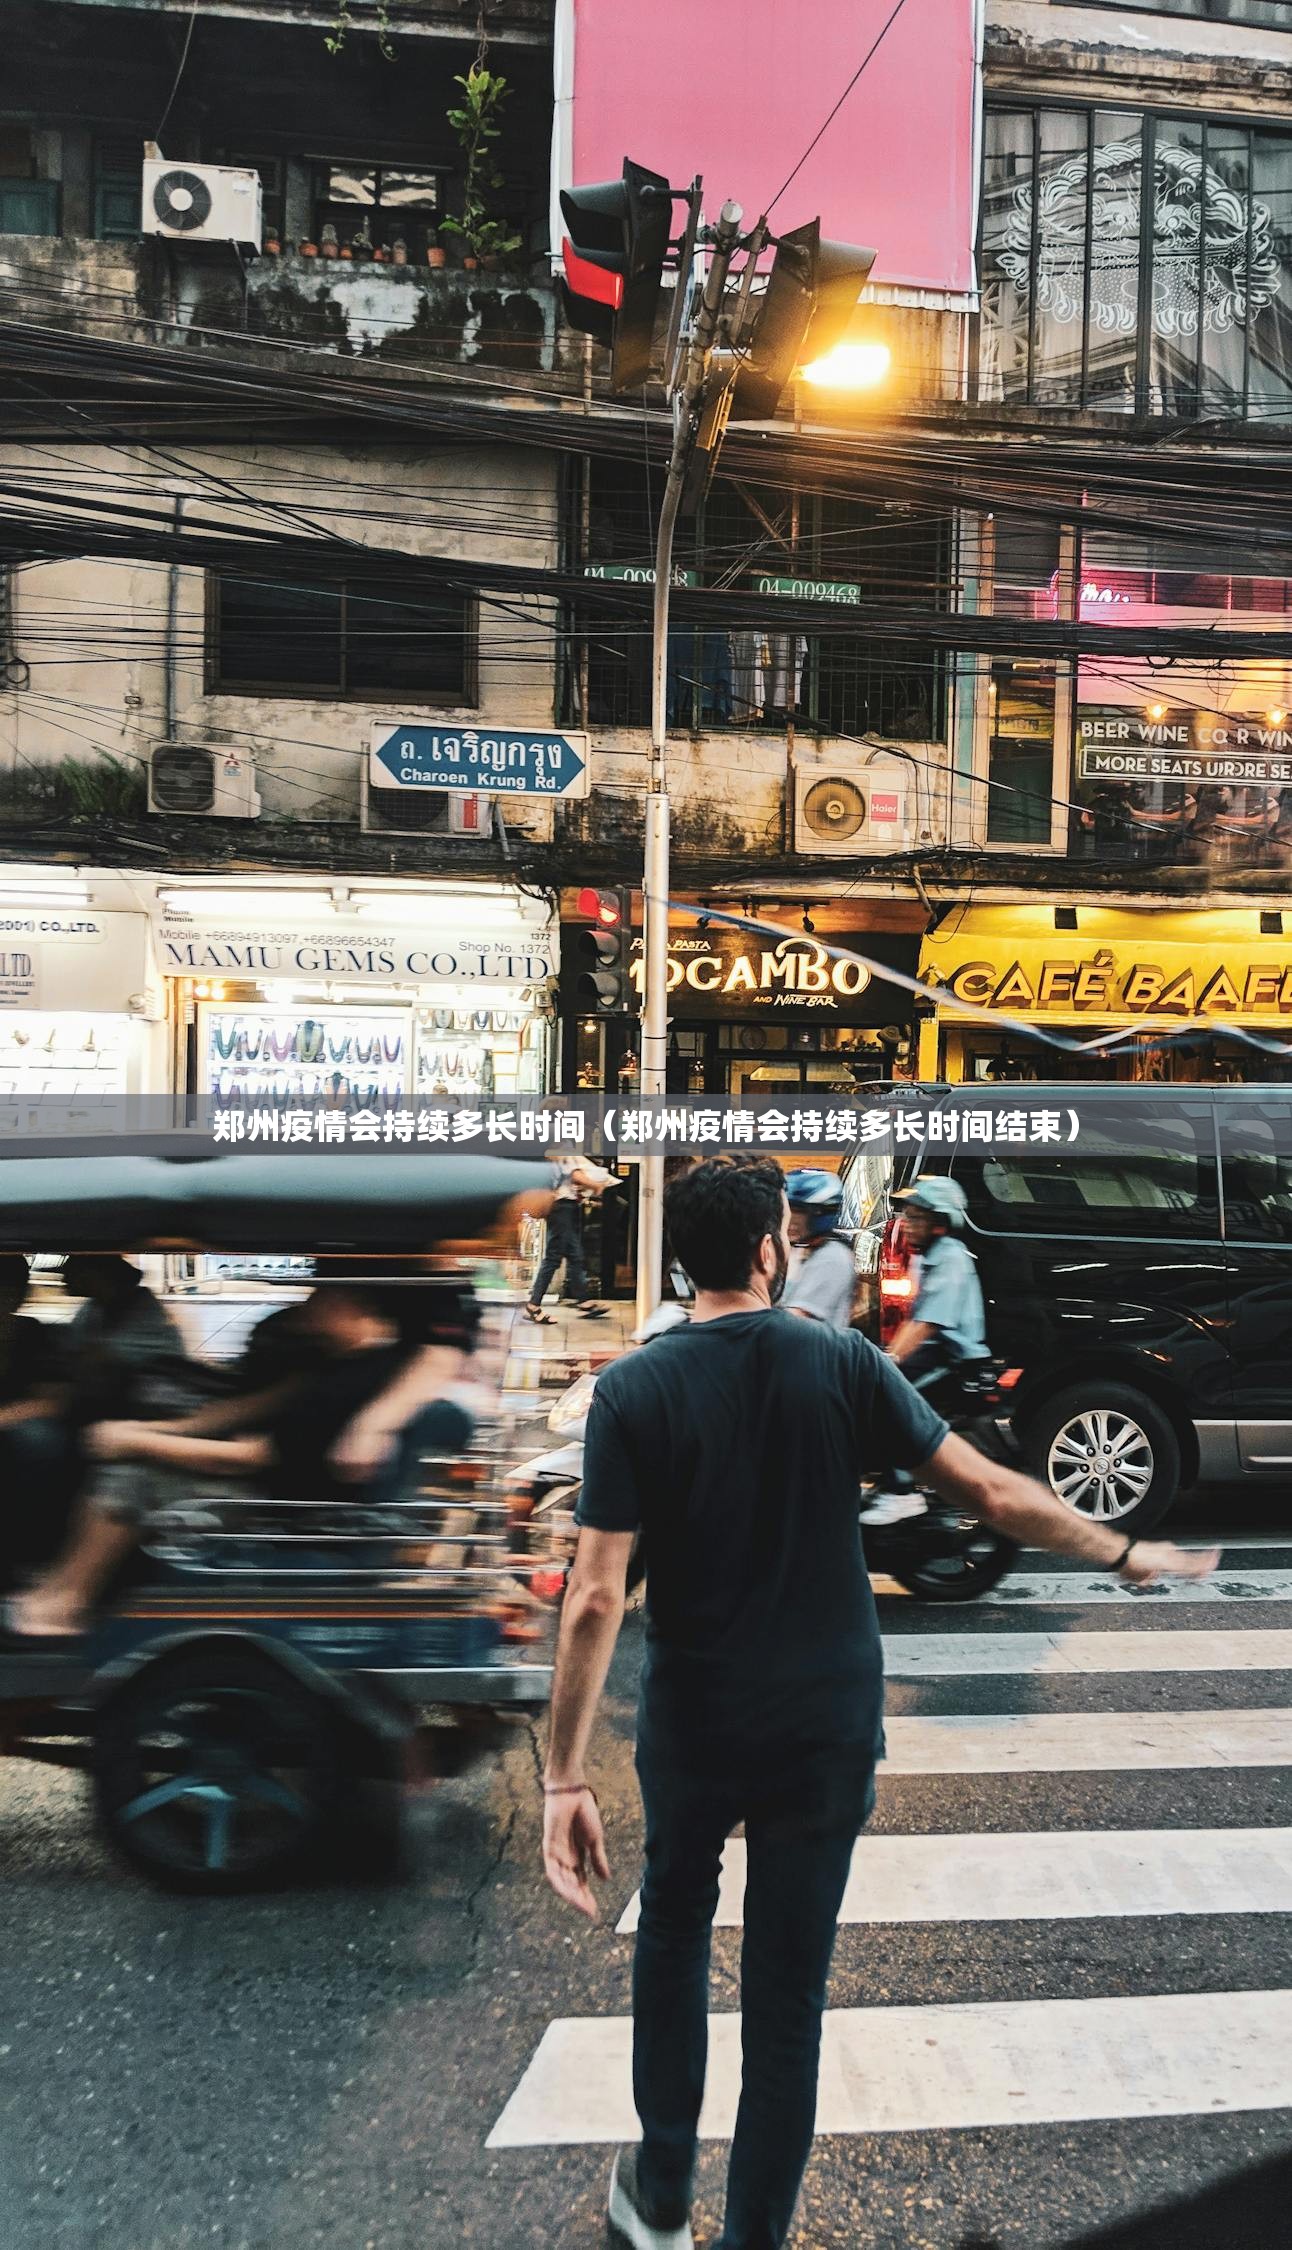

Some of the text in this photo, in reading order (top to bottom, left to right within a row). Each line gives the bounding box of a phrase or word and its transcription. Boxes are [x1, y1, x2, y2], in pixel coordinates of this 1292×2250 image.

[1081, 721, 1129, 739] BEER
[1138, 724, 1189, 742] WINE
[400, 731, 562, 777] ถ. เจริญกรุง
[1095, 756, 1147, 773] MORE
[1151, 758, 1202, 776] SEATS
[1270, 764, 1292, 779] SE
[400, 768, 562, 790] Charoen Krung Rd.
[871, 804, 897, 813] Haier
[459, 941, 491, 954] Shop
[521, 944, 550, 955] 1372
[673, 940, 712, 950] PASTA
[166, 943, 548, 979] MAMU GEMS CO.,LTD
[951, 951, 1113, 1005] CAFÉ
[774, 994, 806, 1006] WINE
[806, 996, 839, 1009] BAR
